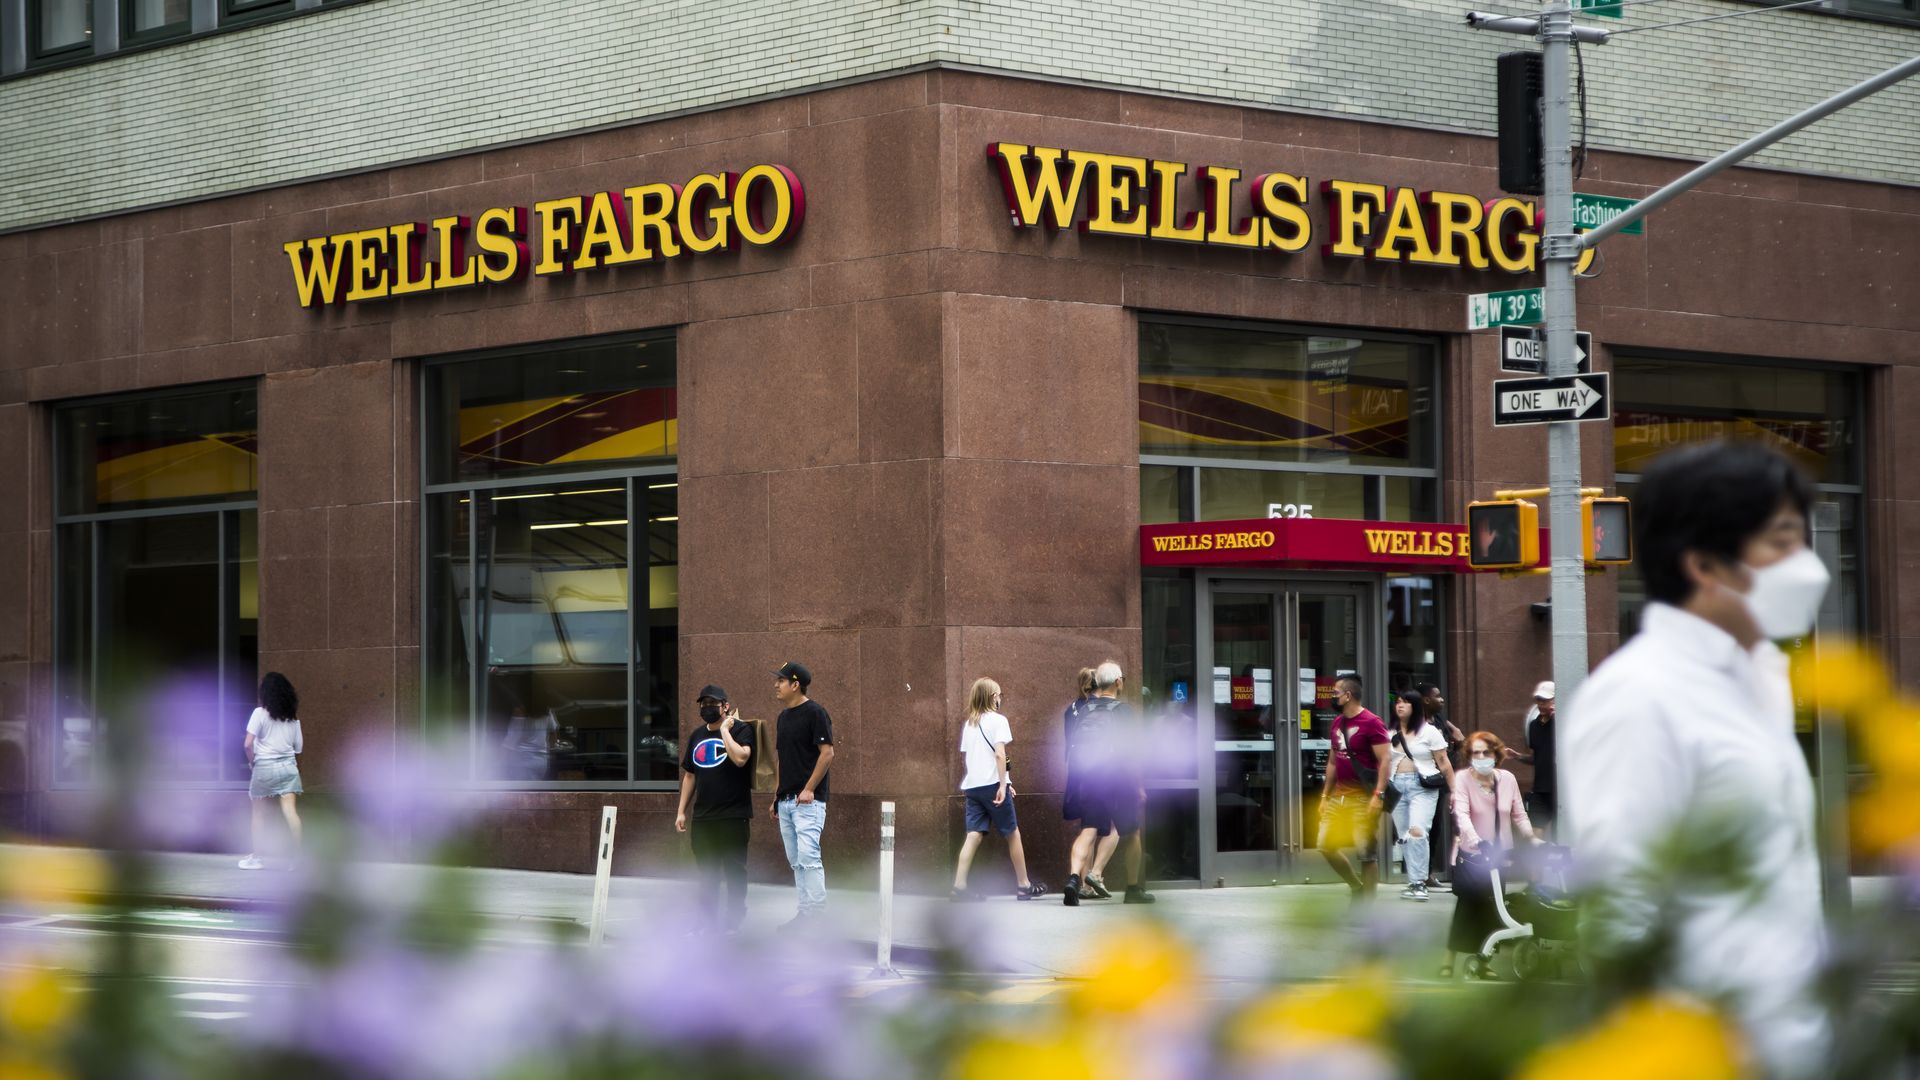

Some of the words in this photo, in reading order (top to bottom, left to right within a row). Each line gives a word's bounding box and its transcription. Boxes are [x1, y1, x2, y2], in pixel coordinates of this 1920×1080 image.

[997, 142, 1311, 252] WELLS
[1327, 179, 1596, 276] FARG
[284, 206, 522, 308] WELLS
[534, 163, 796, 275] FARGO
[1489, 297, 1502, 322] W
[1507, 295, 1526, 321] 39
[1515, 340, 1540, 359] ONE
[1511, 393, 1541, 410] ONE
[1557, 389, 1590, 407] WAY
[1153, 534, 1212, 552] WELLS
[1215, 531, 1275, 549] FARGO
[1364, 529, 1453, 557] WELLS
